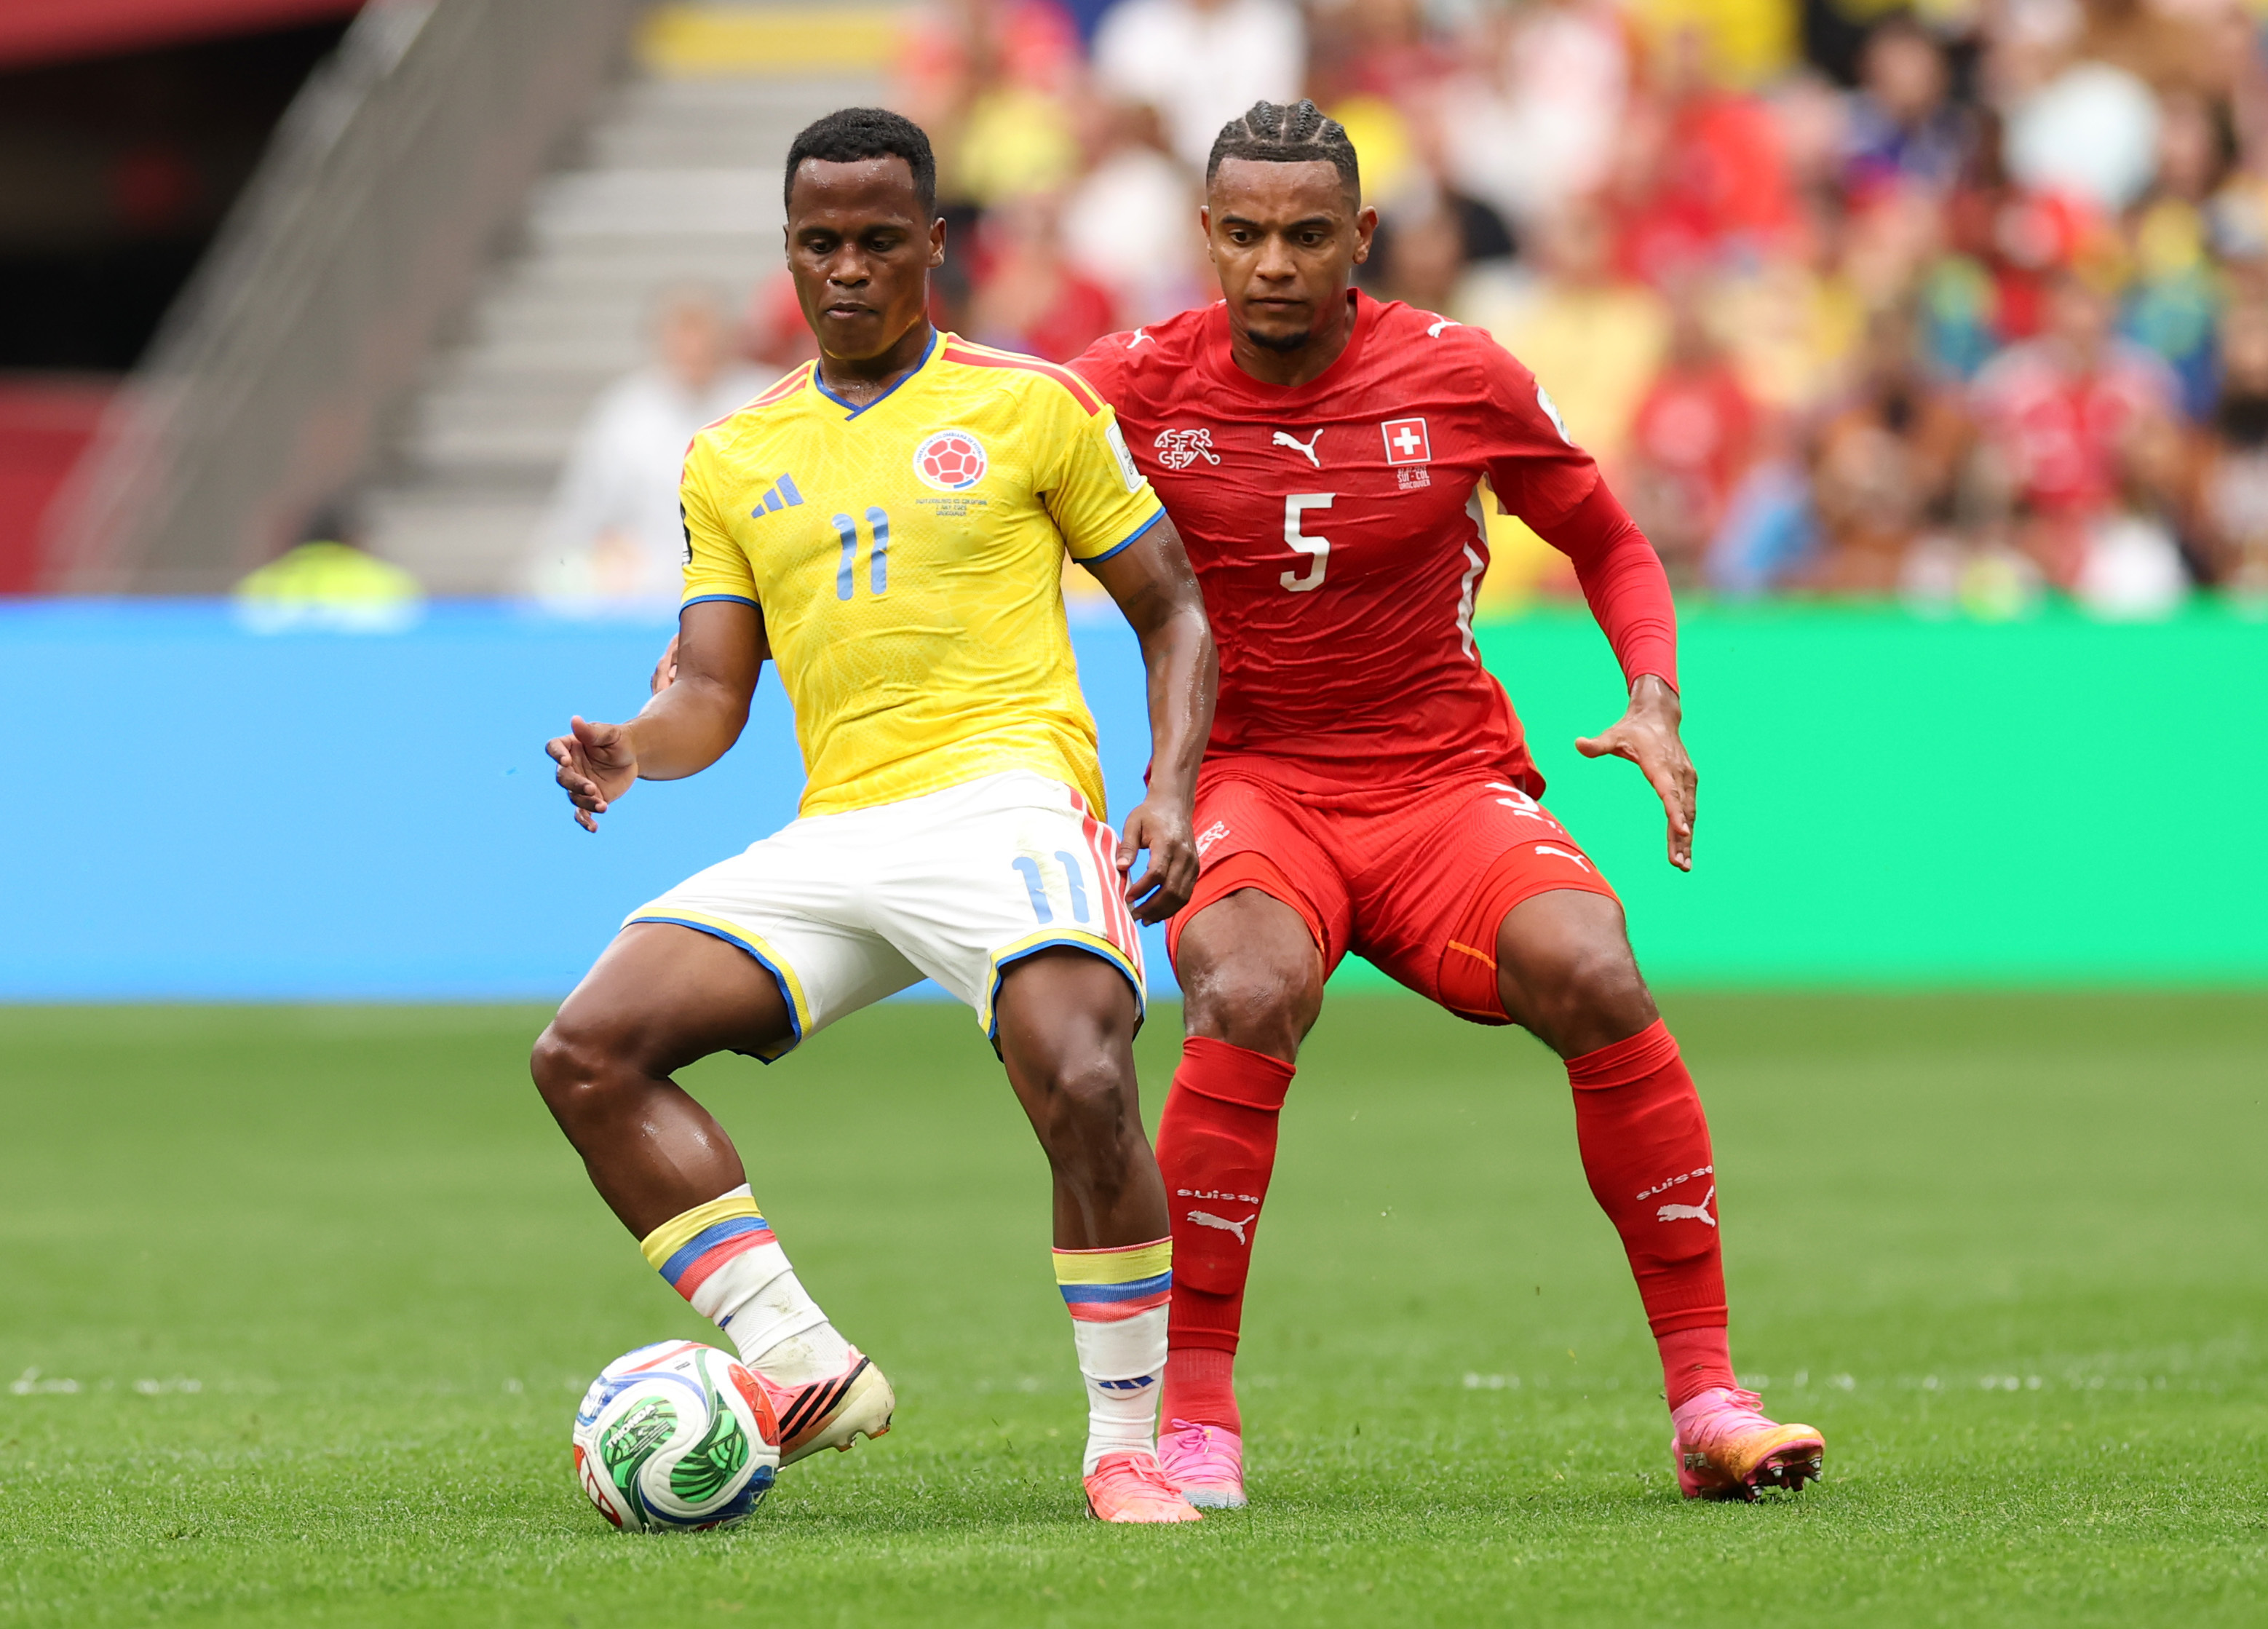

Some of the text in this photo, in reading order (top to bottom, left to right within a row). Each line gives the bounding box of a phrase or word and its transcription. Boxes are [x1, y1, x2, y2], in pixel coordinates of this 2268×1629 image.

[1397, 472, 1410, 483] SUI
[1416, 469, 1430, 480] COL
[832, 506, 889, 601] 11
[1280, 492, 1337, 592] 5
[1012, 850, 1090, 924] 11
[1176, 1189, 1259, 1205] suisse
[1636, 1165, 1713, 1201] suisse
[606, 1404, 656, 1448] TRIONDA
